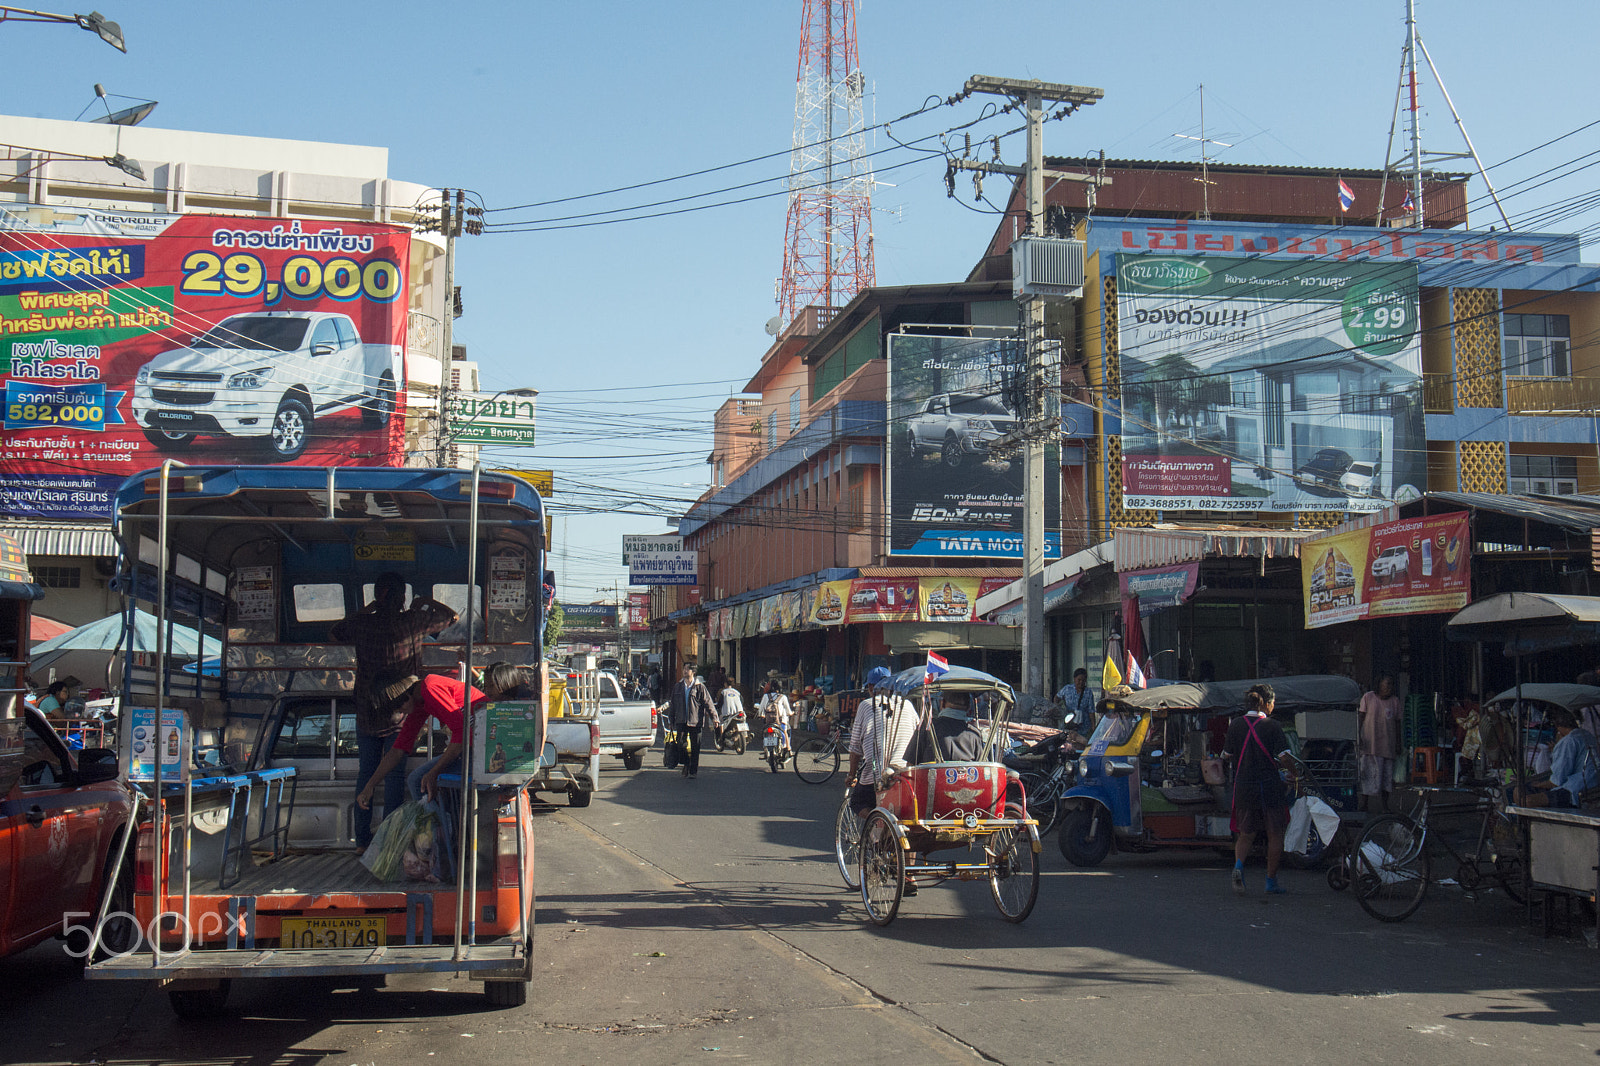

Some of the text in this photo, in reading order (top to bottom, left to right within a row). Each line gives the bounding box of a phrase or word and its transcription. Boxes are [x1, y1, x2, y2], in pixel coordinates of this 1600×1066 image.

[94, 215, 169, 226] CHEVROLET
[213, 220, 373, 253] ดาวน์ต่ำเพียง
[181, 250, 402, 305] 29,000
[20, 291, 109, 313] พิเศษสุด!
[119, 306, 172, 328] แม่ค้า
[1348, 306, 1406, 328] 2.99
[11, 339, 101, 360] เชฟโรเลต
[11, 358, 101, 380] โคโลราโด
[17, 387, 95, 404] ราคาเริ่มต้น
[8, 404, 104, 424] 582,000
[99, 439, 140, 450] ทะเบียน
[1127, 499, 1264, 509] 082-3688551, 082-7525957
[937, 537, 1052, 552] TATA MOTS
[367, 919, 378, 927] 36
